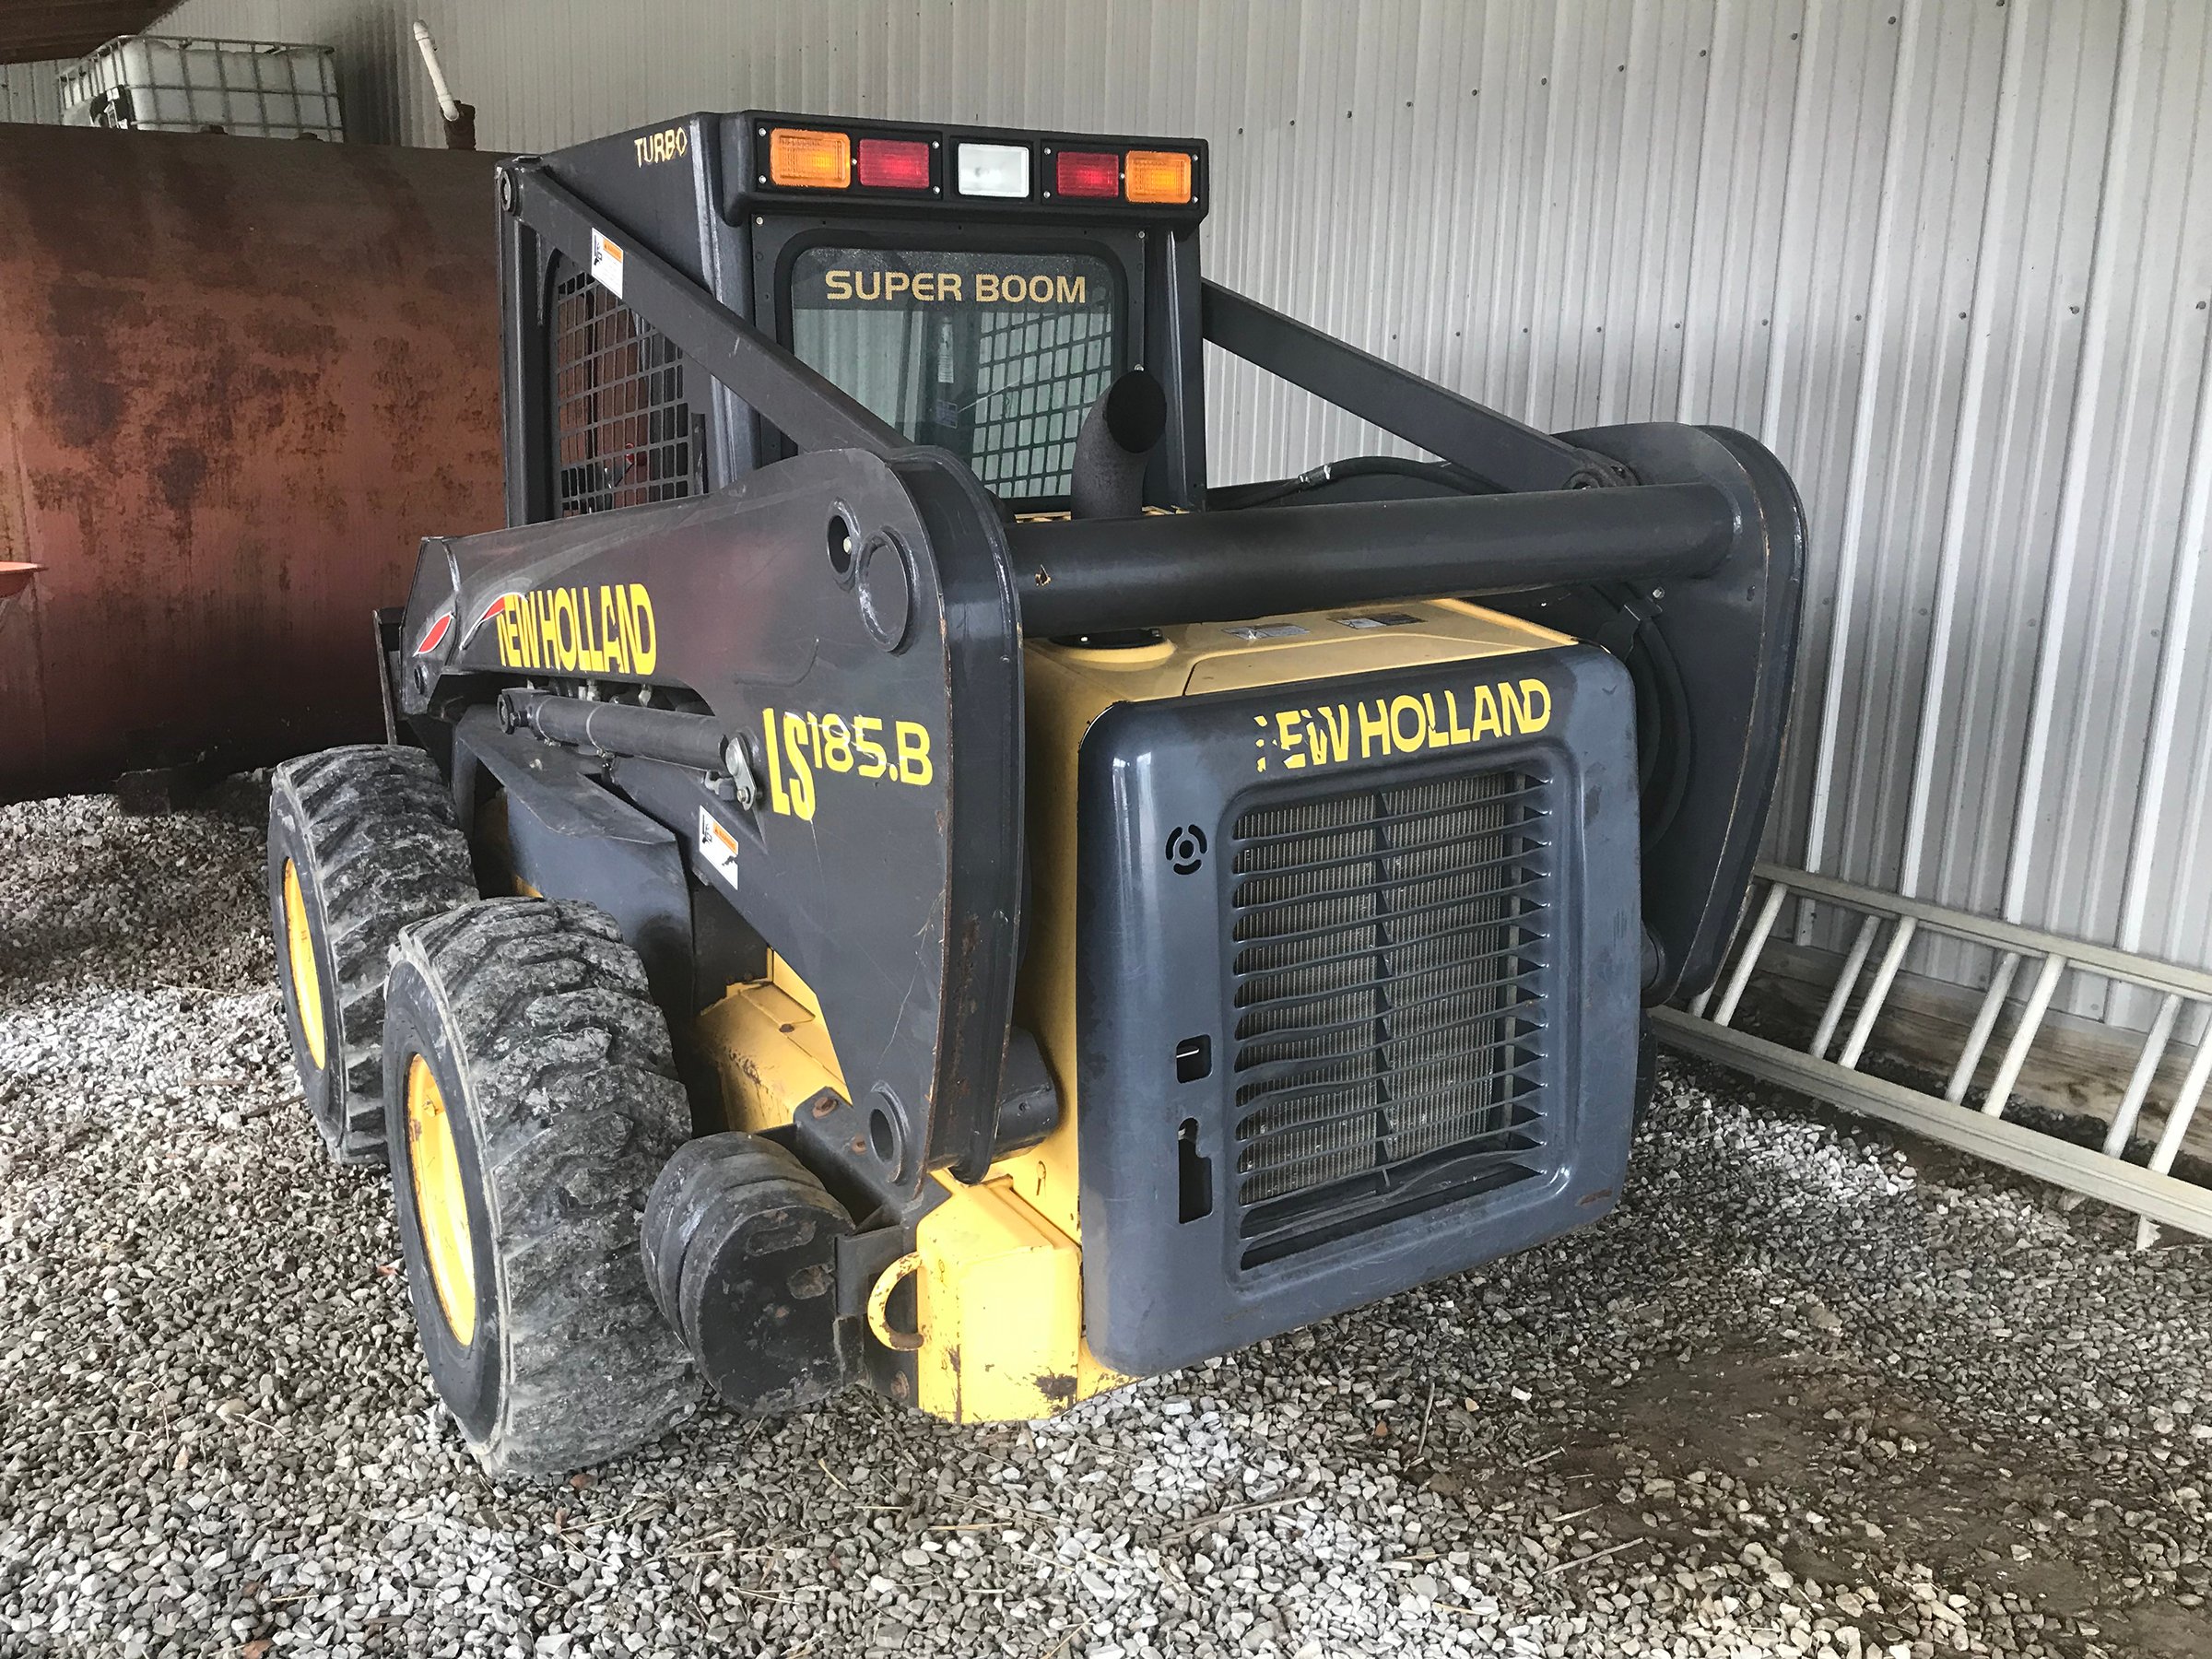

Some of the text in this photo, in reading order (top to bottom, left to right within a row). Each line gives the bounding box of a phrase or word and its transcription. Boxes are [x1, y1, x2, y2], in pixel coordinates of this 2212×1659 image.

[634, 127, 688, 168] TURBO
[825, 270, 1086, 303] SUPER BOOM
[496, 583, 657, 676] NEW HOLLAND
[1358, 678, 1551, 759] HOLLAND
